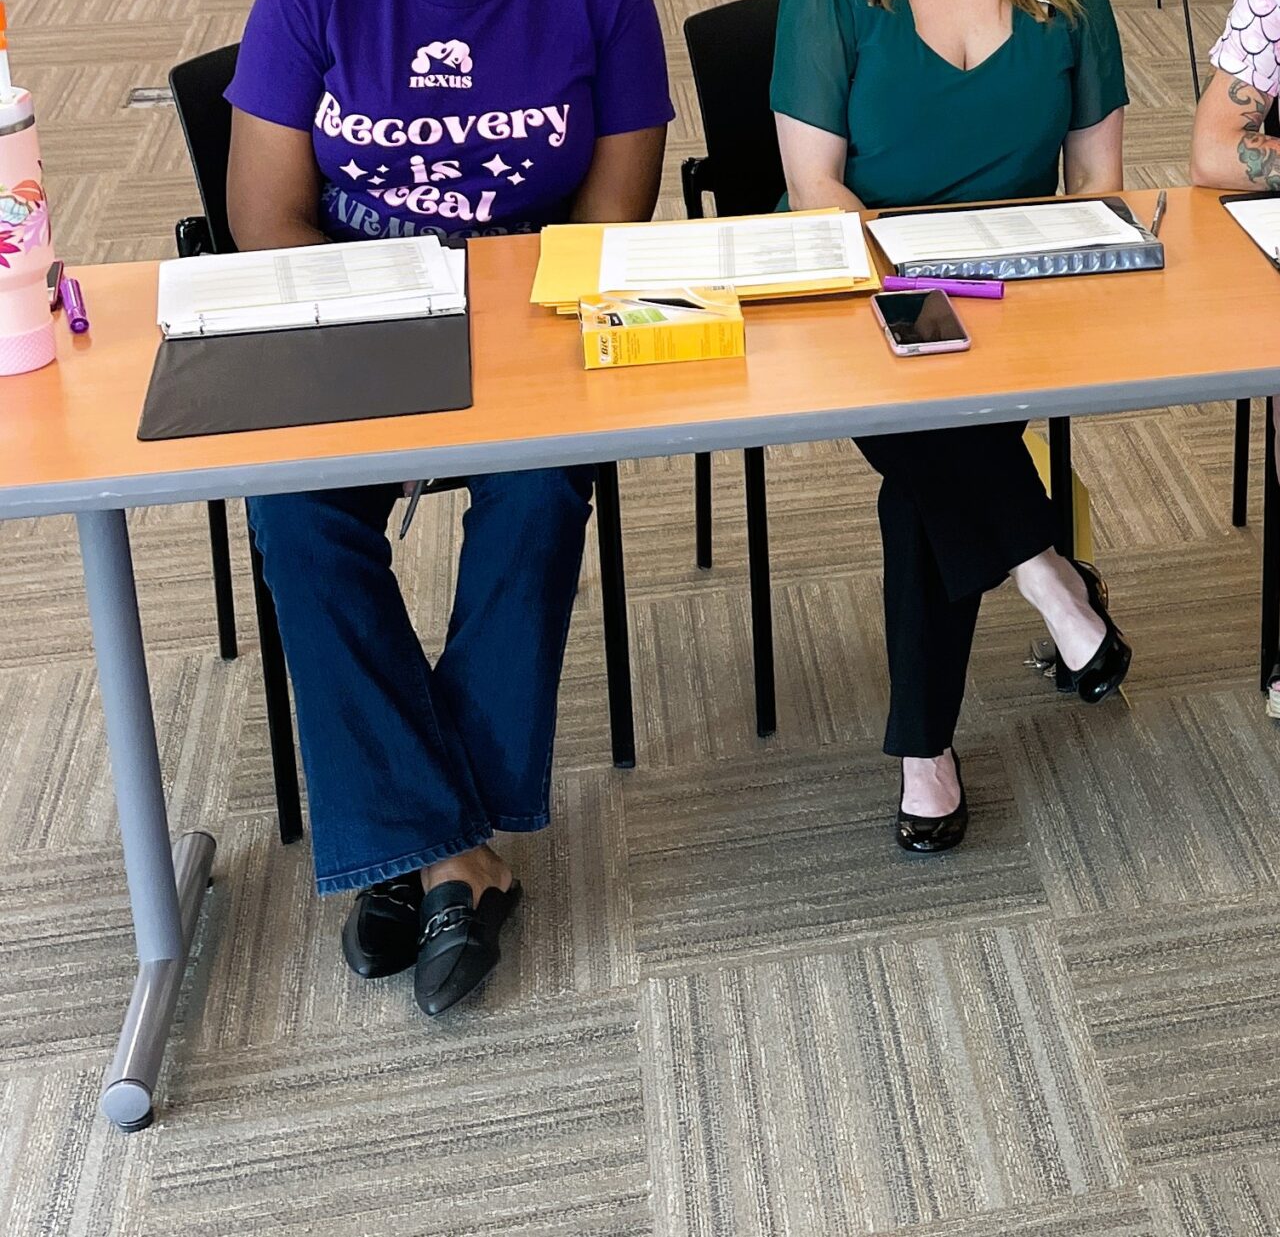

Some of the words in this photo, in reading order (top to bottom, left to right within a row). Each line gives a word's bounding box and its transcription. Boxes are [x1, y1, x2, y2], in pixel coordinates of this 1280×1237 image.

[409, 74, 472, 88] nexus
[315, 91, 570, 147] Recovery
[410, 155, 462, 183] is
[600, 335, 609, 355] BIC
